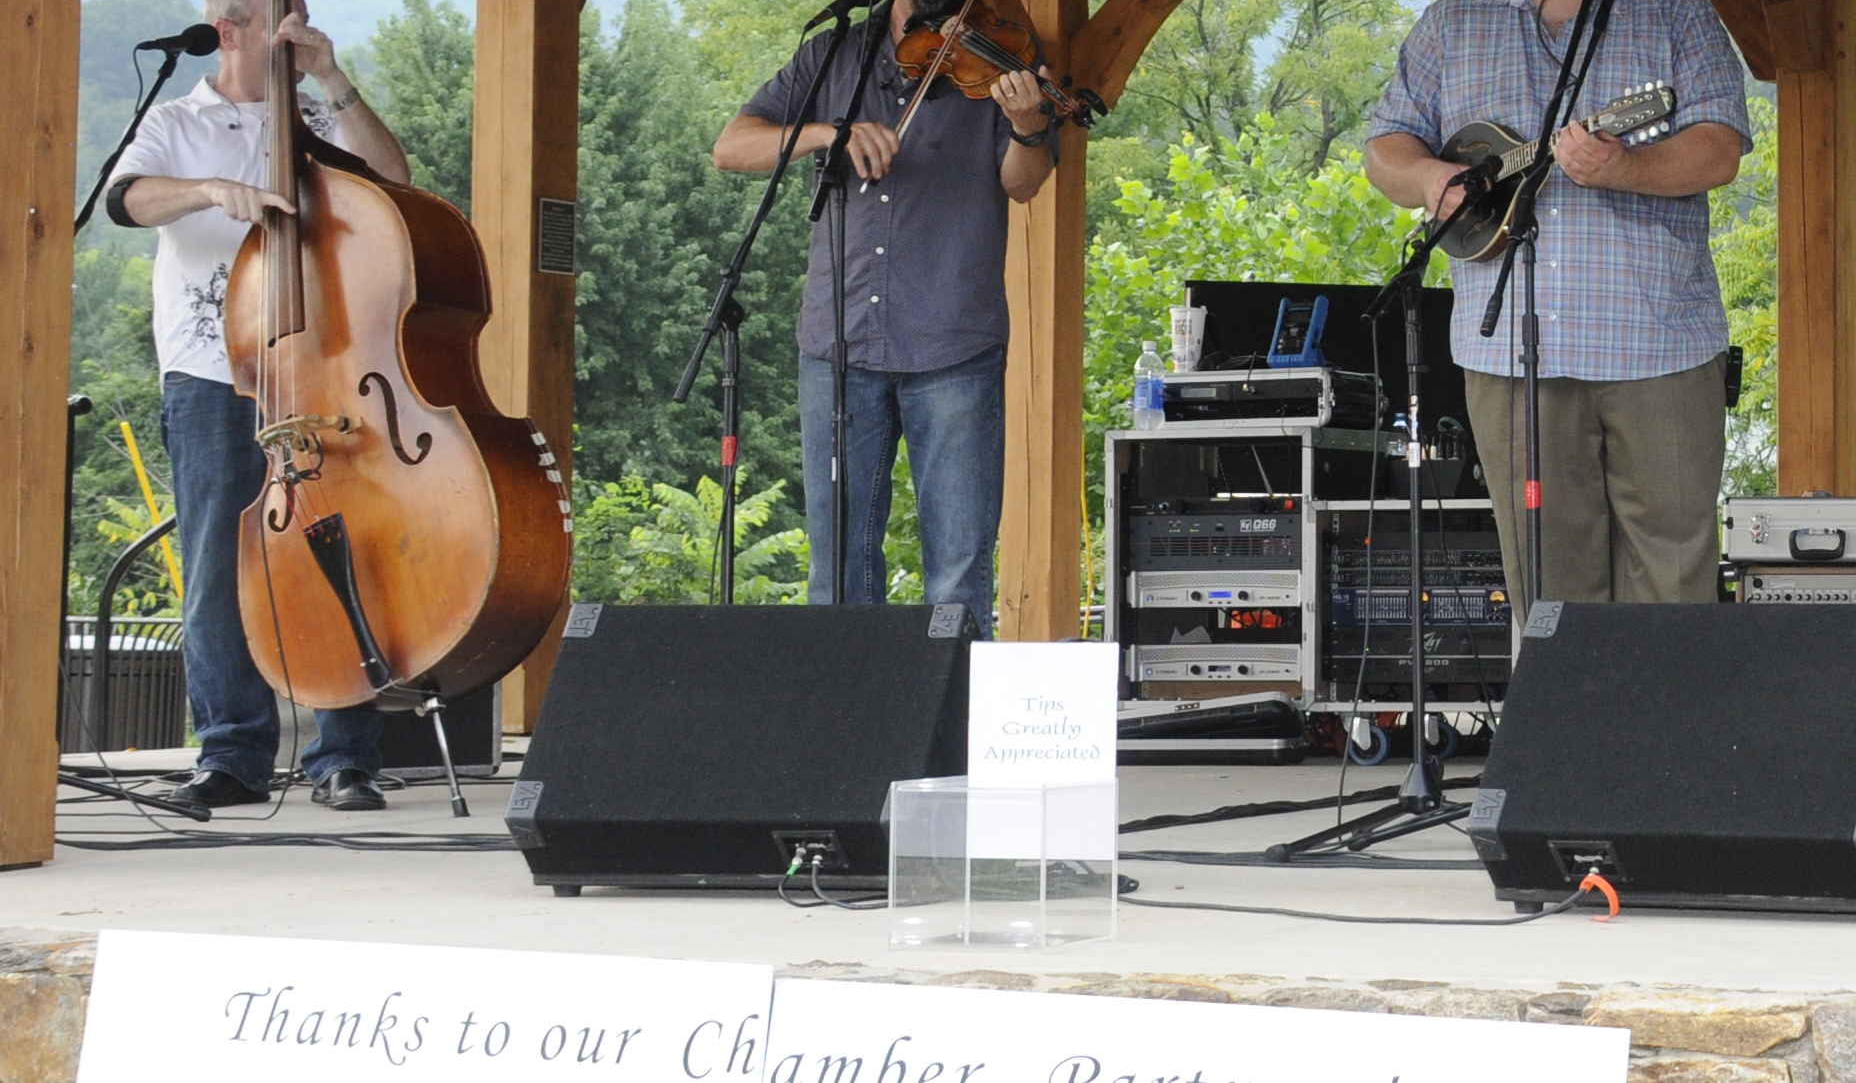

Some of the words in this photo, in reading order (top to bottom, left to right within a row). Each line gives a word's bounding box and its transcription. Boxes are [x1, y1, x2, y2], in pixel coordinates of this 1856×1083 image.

[1020, 696, 1064, 715] Tips
[1002, 716, 1082, 739] Greatly
[983, 744, 1101, 764] Appreciated
[225, 986, 429, 1066] Thanks
[457, 1011, 511, 1058] to
[540, 1024, 641, 1065] our
[682, 1014, 985, 1083] Chamber
